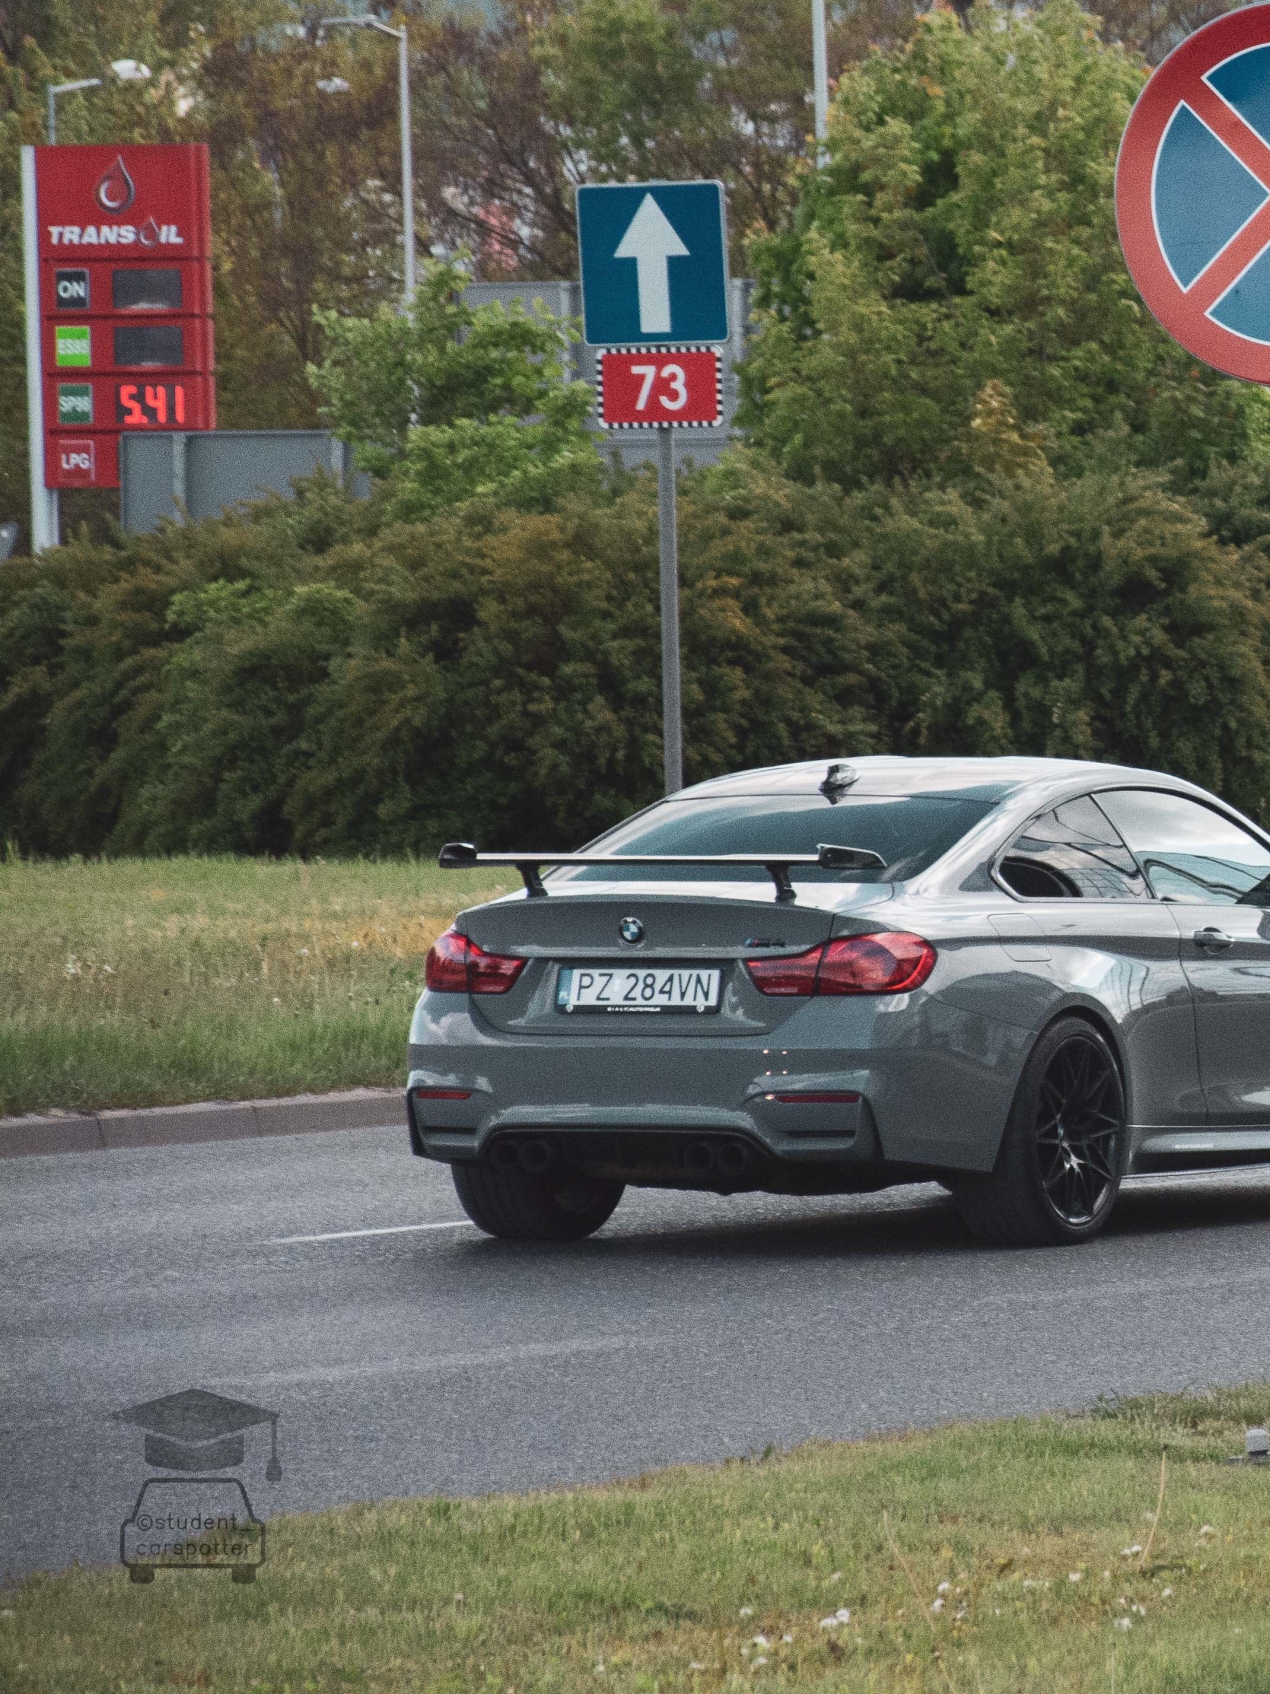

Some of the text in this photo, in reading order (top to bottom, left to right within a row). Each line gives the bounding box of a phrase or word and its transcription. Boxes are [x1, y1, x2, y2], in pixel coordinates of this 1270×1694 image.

[58, 281, 86, 298] ON
[631, 363, 688, 411] 73
[61, 453, 90, 470] LPG
[577, 972, 712, 1002] PZ 284VN
